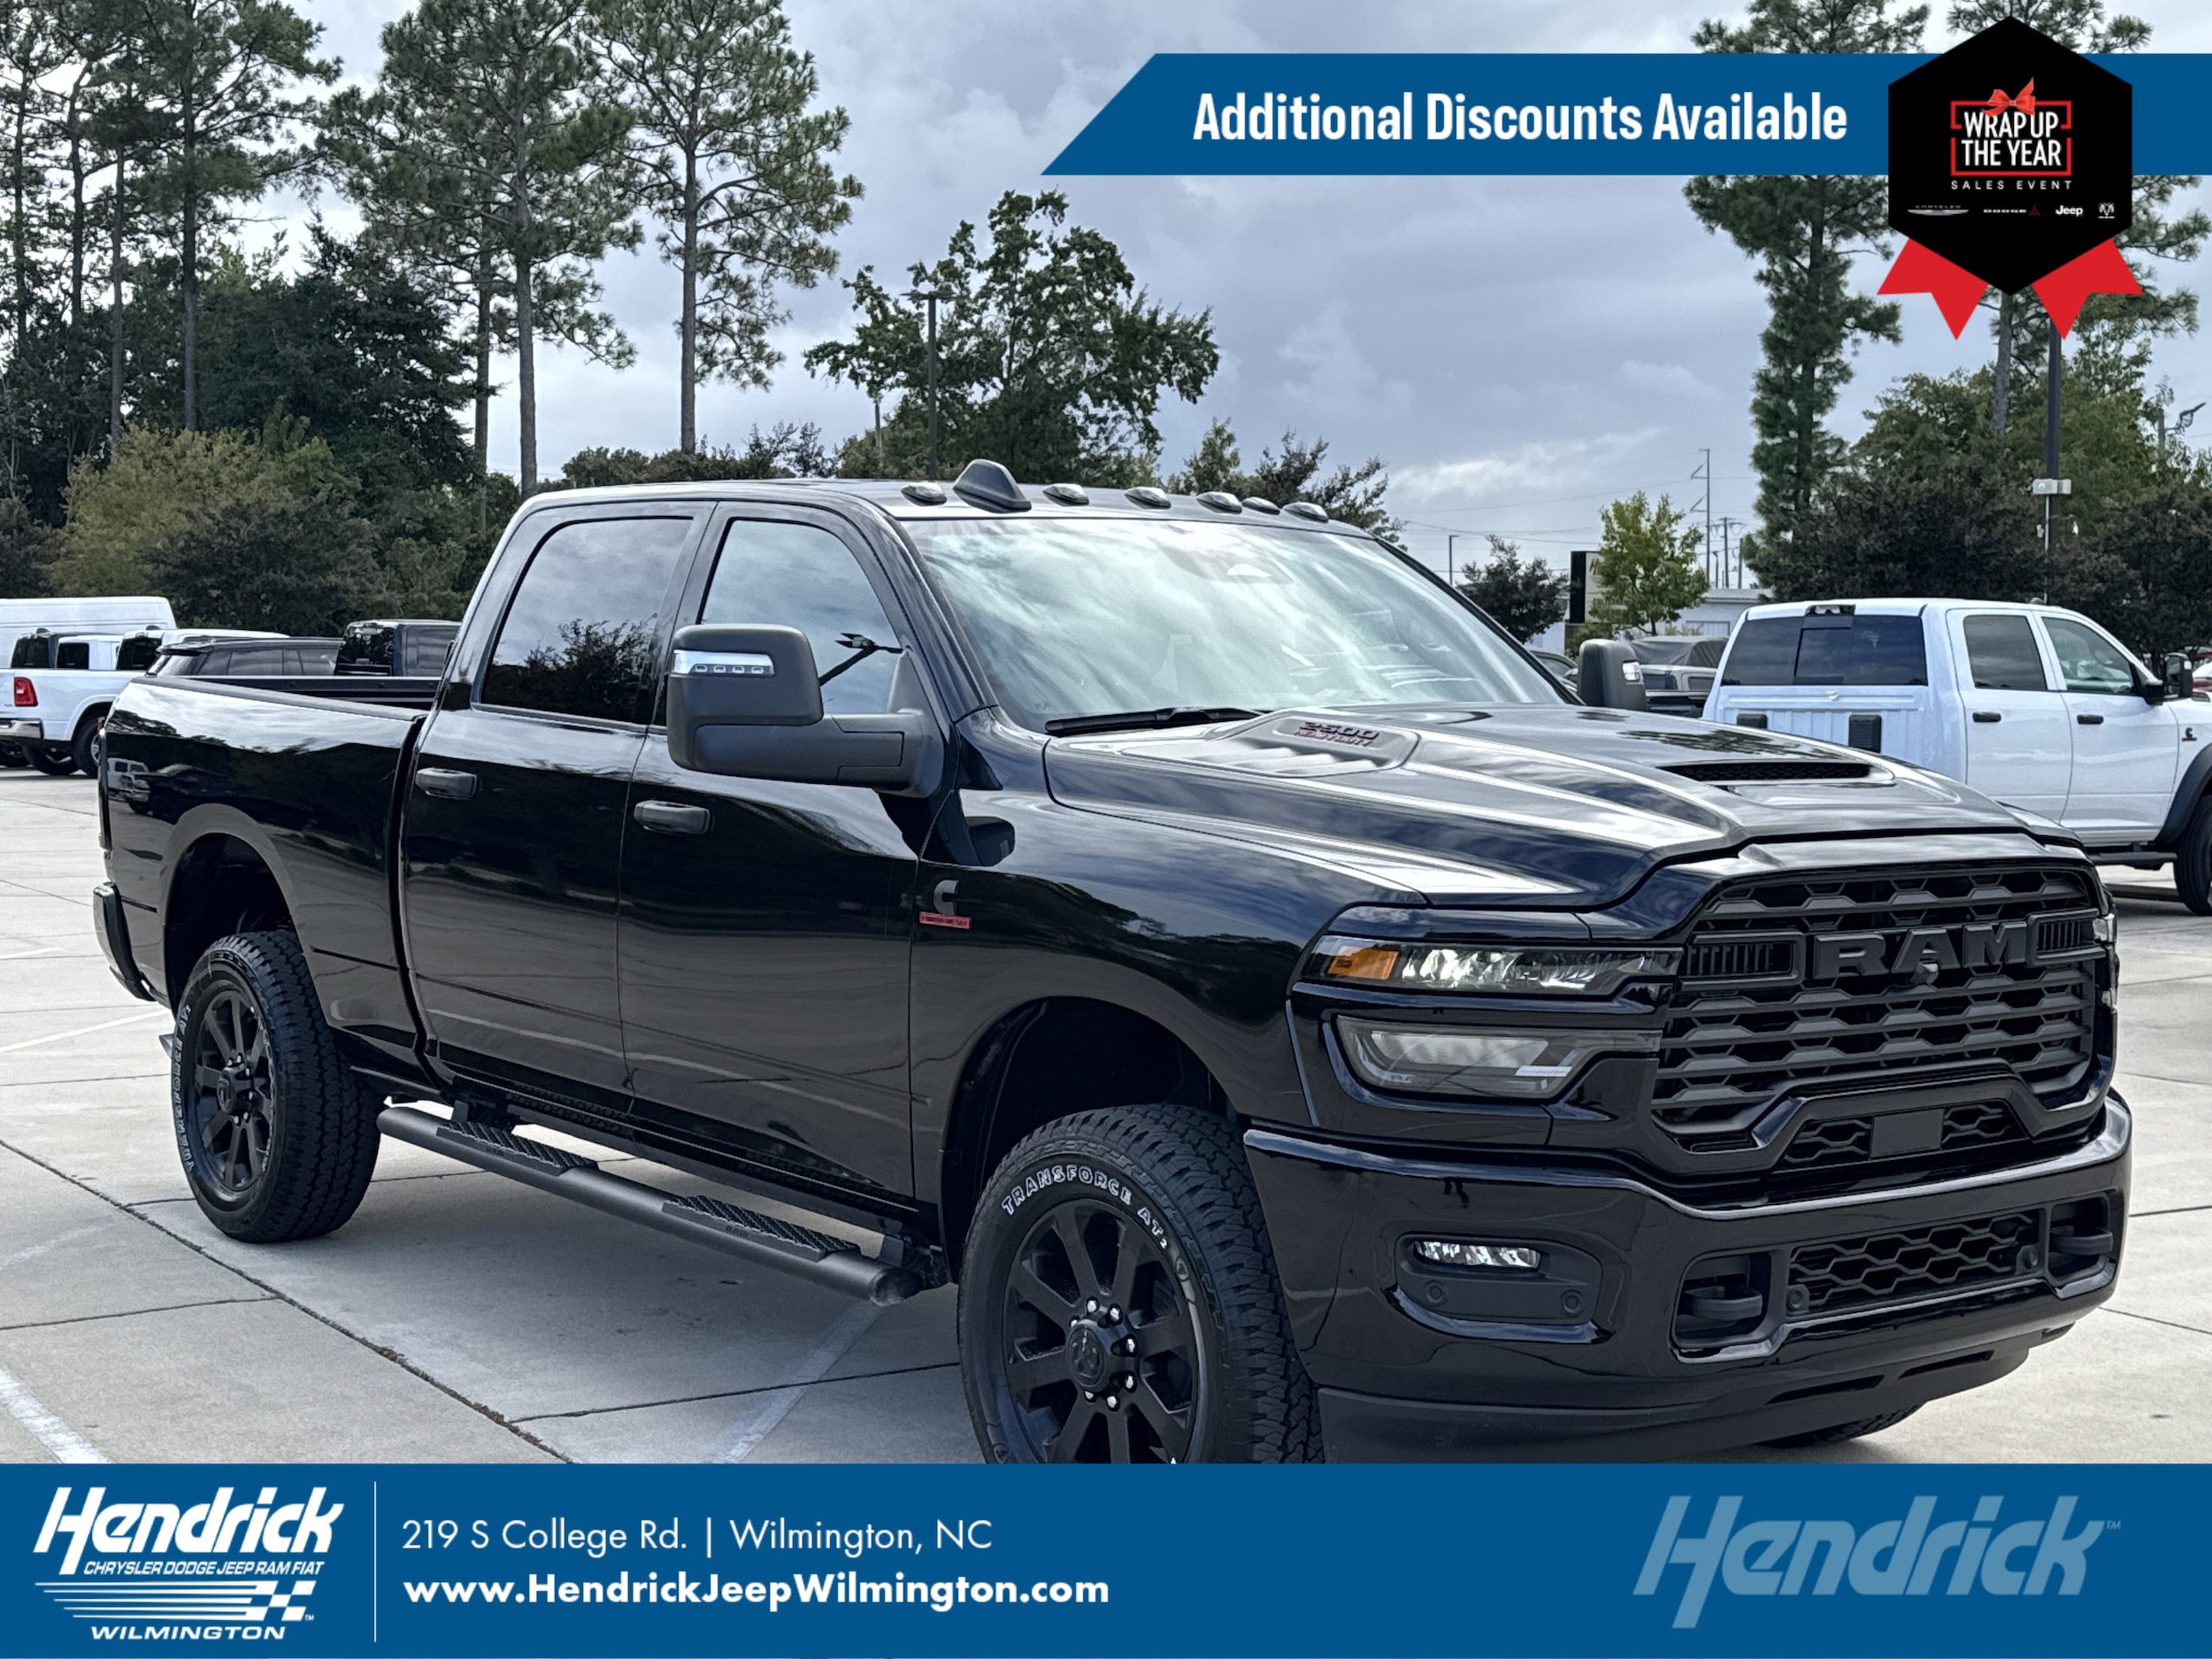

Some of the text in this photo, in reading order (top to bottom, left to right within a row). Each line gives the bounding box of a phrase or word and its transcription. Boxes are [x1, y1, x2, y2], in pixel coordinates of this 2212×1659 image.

[1300, 722, 1379, 740] 2500
[1814, 920, 2027, 979] RAM
[1001, 1164, 1133, 1217] TRANSFORCE
